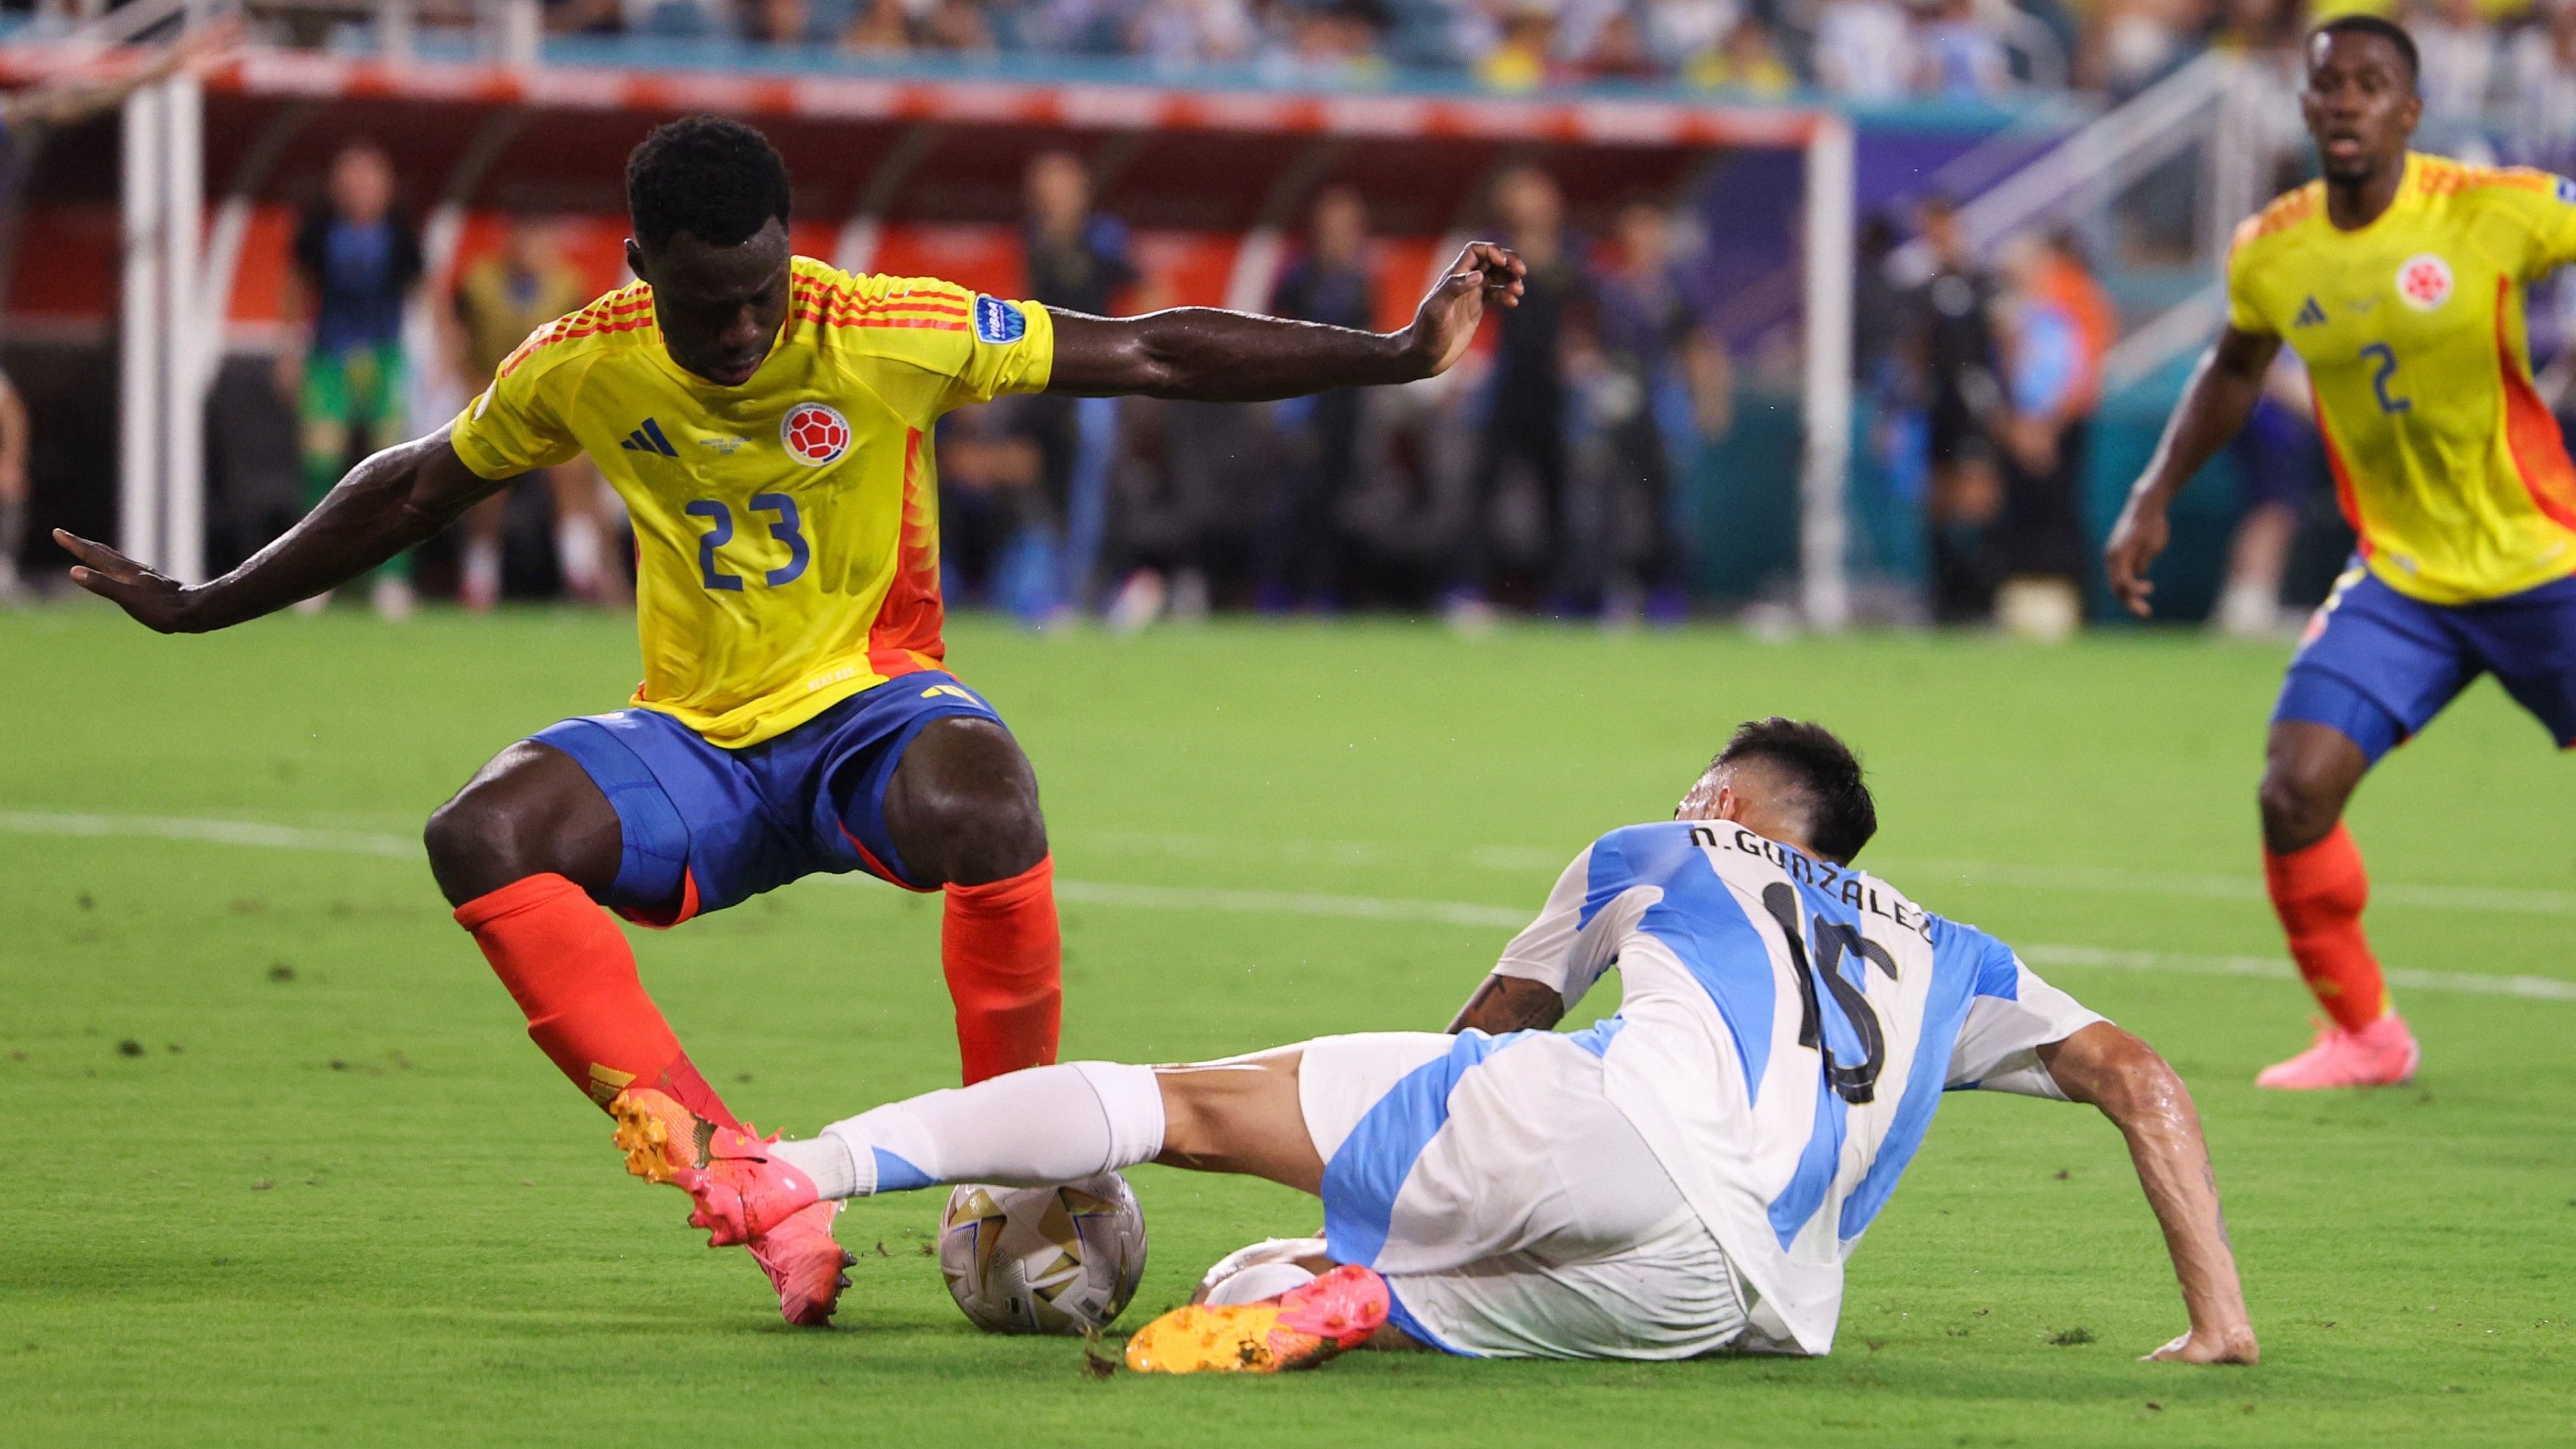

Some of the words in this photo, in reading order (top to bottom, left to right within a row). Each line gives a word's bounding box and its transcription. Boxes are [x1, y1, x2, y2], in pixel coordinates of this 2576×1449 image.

[2360, 342, 2412, 413] 2
[685, 493, 810, 592] 23
[1762, 882, 1899, 1105] 15
